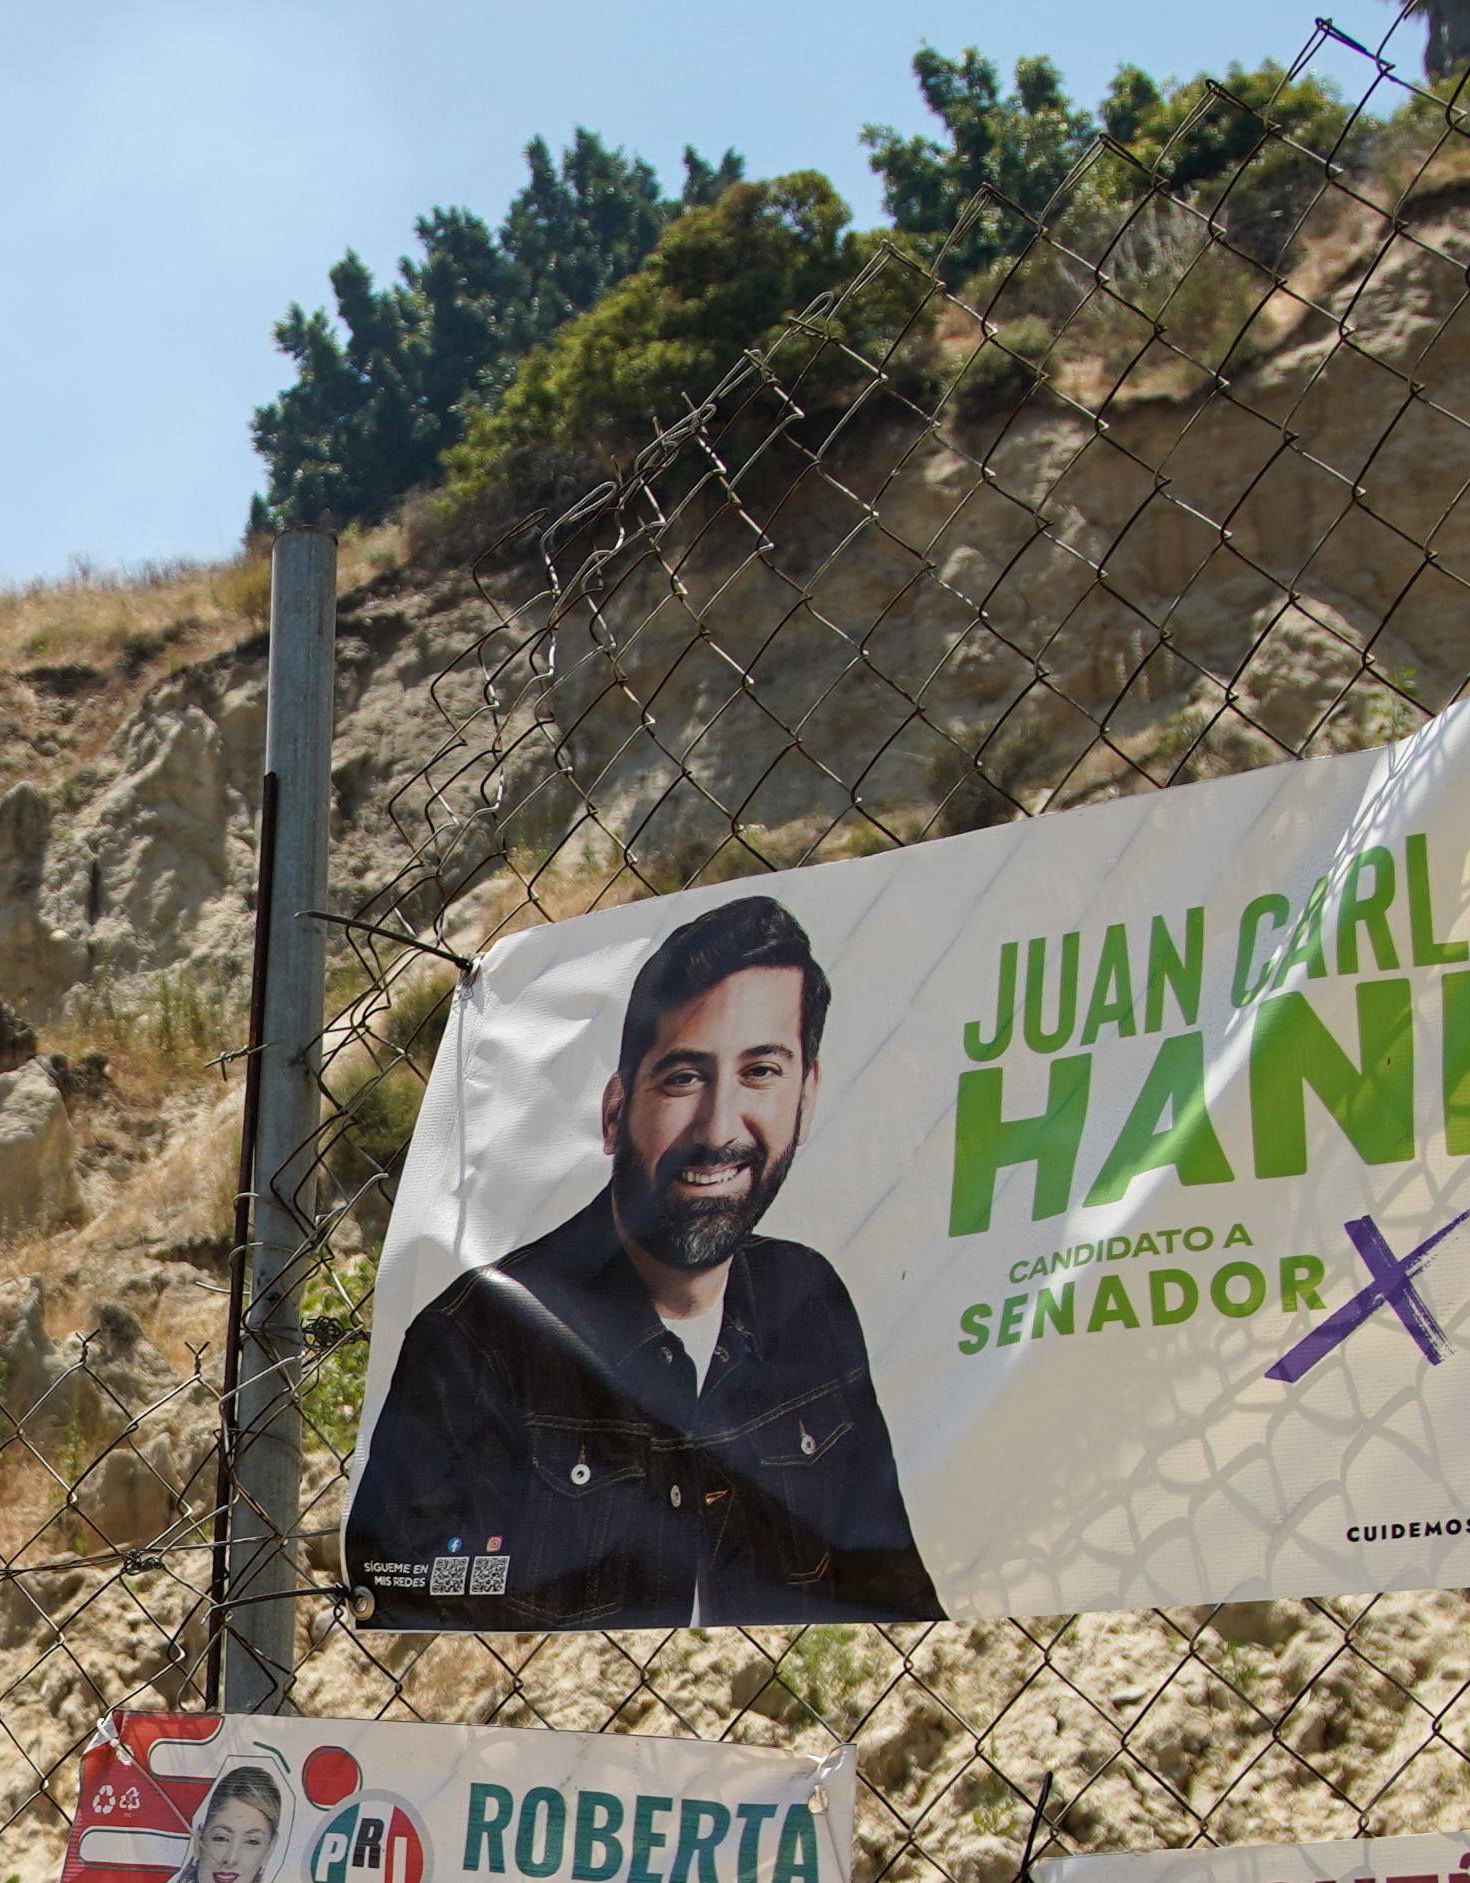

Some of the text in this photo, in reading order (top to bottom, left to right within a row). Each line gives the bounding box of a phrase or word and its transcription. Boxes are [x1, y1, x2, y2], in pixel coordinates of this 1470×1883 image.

[964, 906, 1204, 1061] JUAN
[1009, 1223, 1253, 1283] CANDIDATO A
[957, 1254, 1327, 1355] SENADOR
